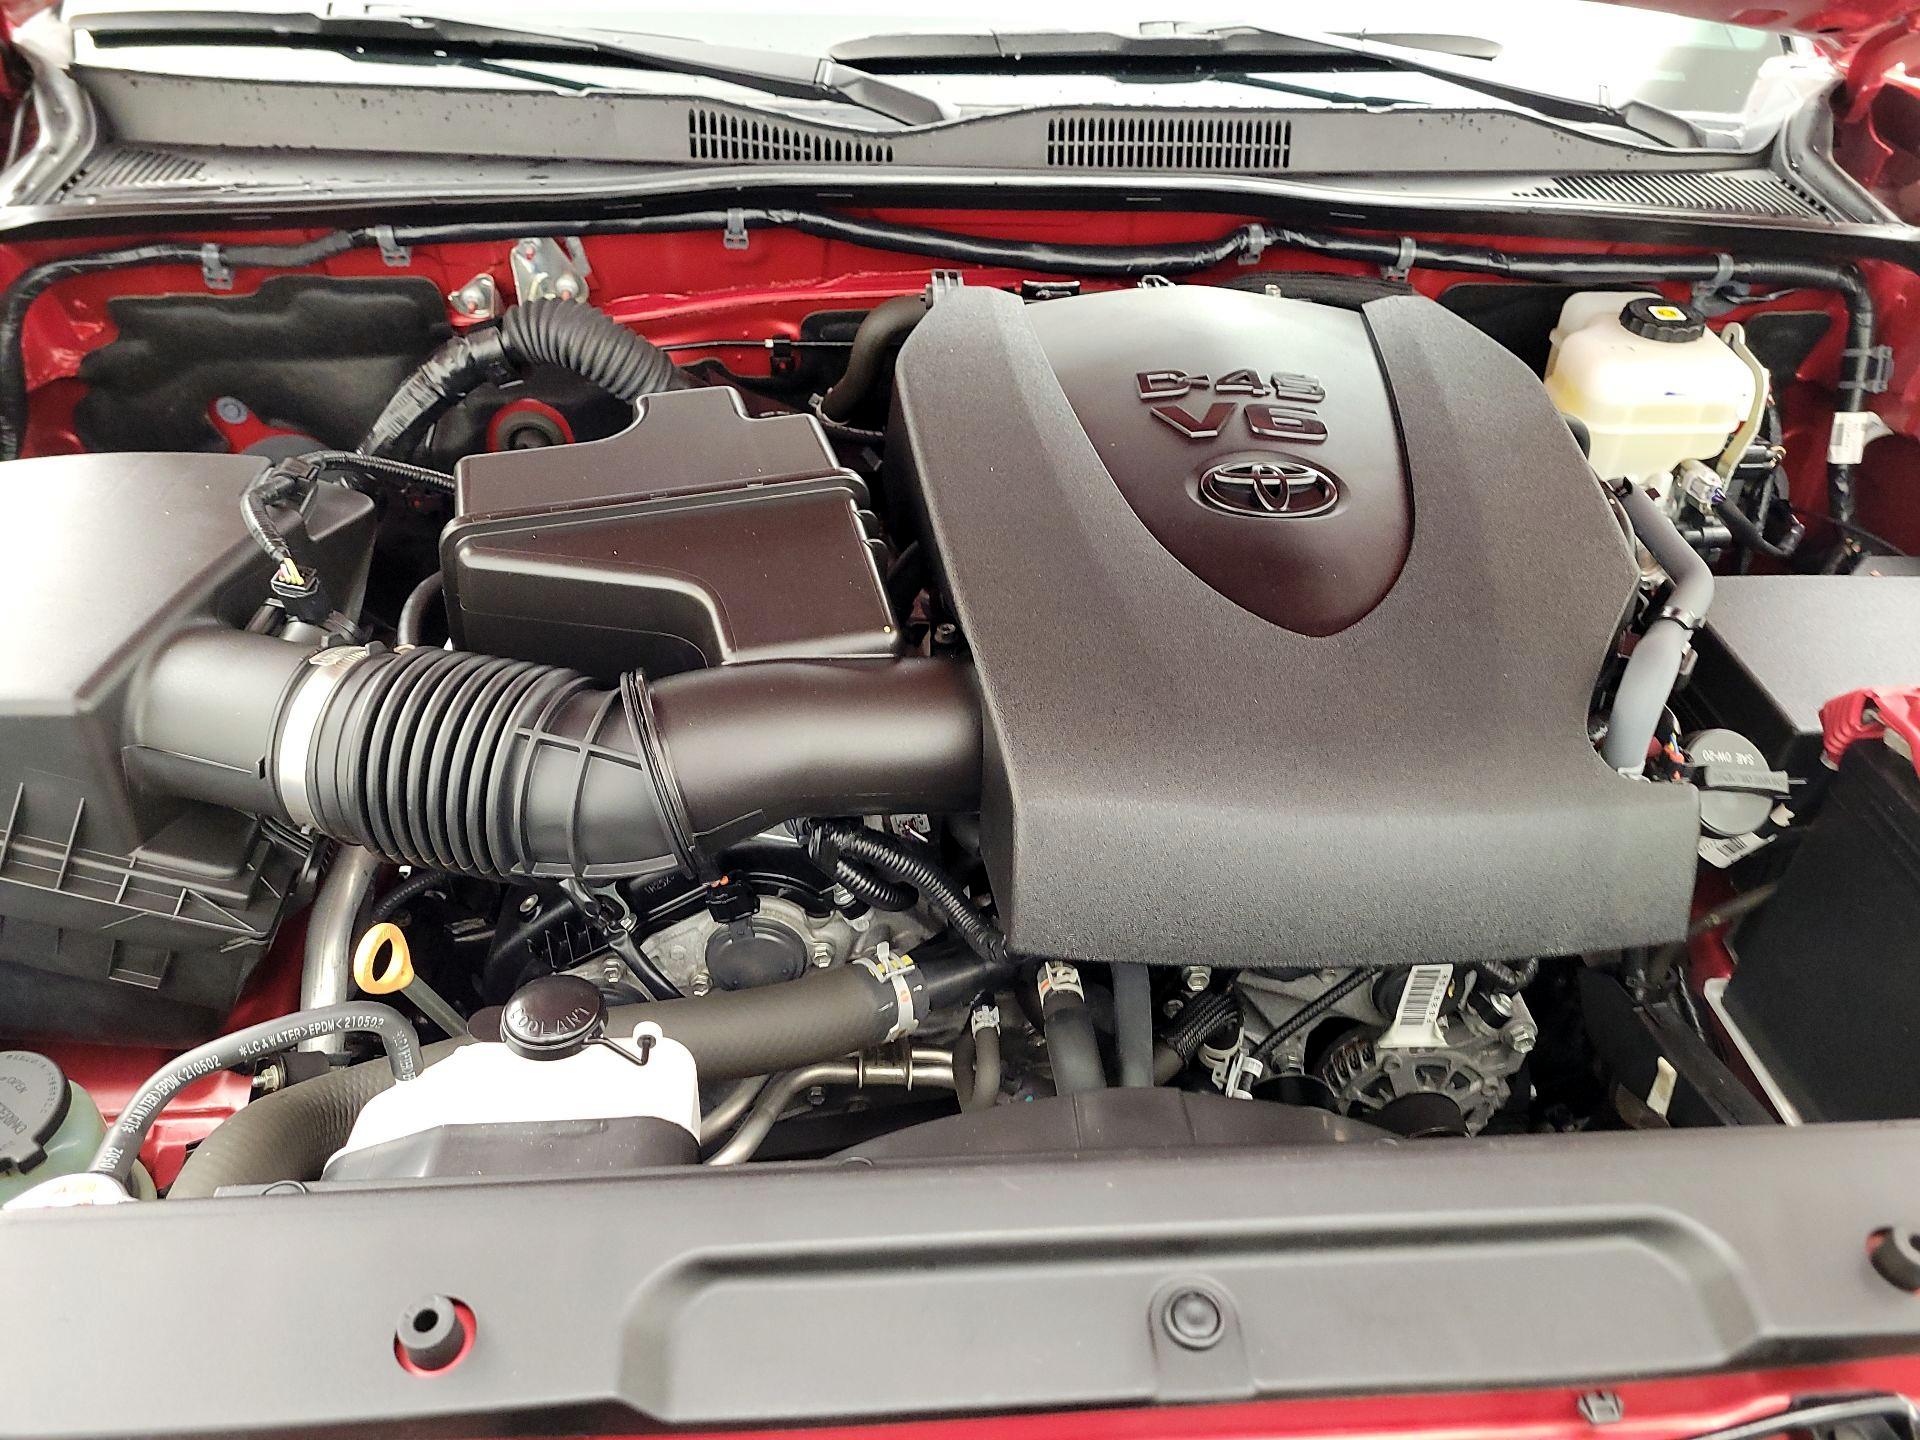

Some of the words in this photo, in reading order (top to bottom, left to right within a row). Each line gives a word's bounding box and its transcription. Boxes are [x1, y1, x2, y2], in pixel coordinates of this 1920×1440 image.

[1135, 368, 1327, 403] D-4S
[1150, 402, 1329, 442] V6
[1735, 752, 1755, 766] SAE
[510, 1006, 590, 1035] COOLANT
